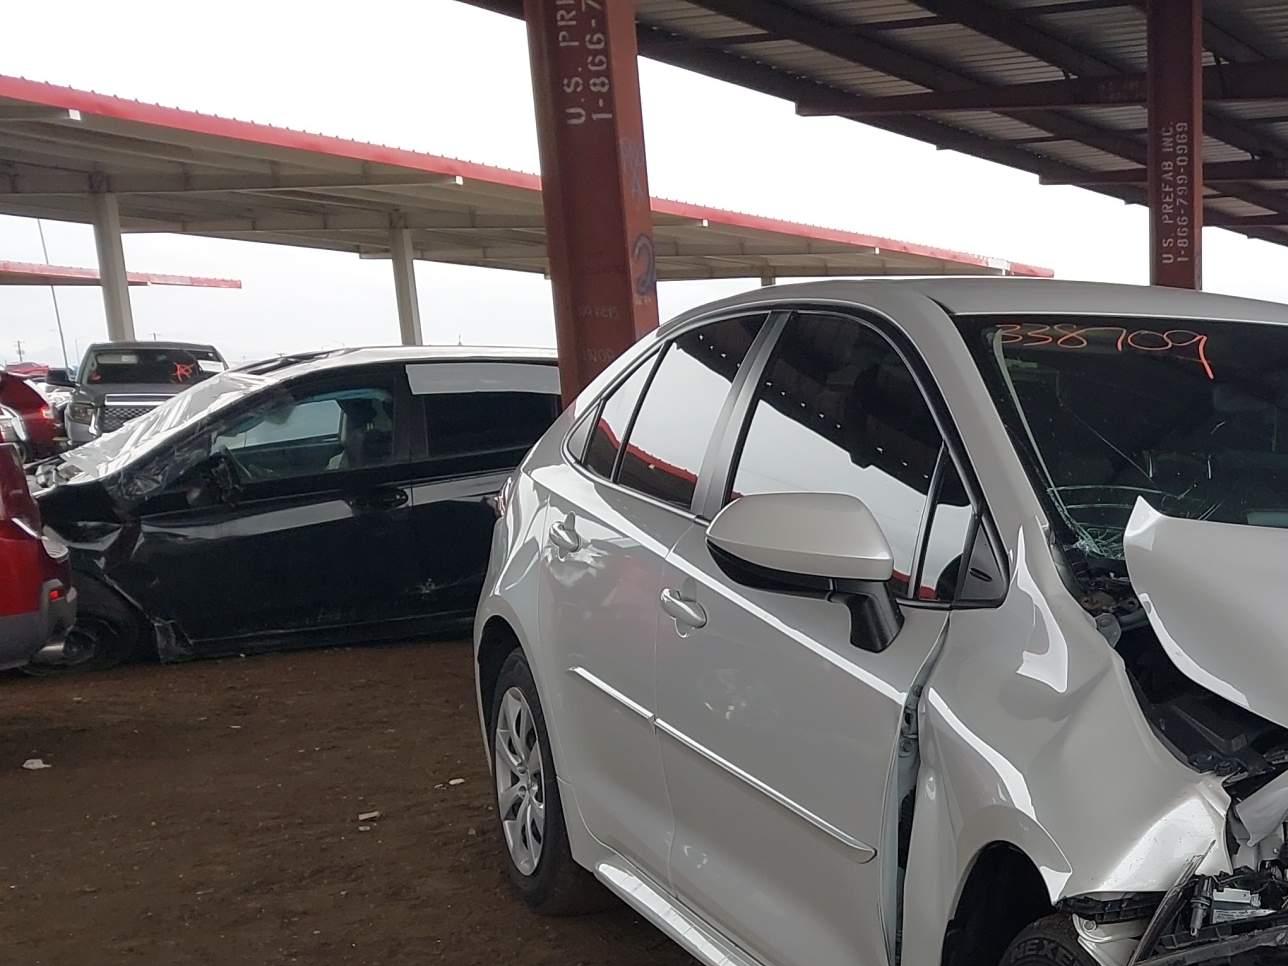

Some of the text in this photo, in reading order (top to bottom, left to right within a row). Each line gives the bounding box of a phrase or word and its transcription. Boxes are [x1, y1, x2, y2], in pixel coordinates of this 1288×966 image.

[562, 66, 587, 125] U.S.
[1161, 161, 1174, 224] PREFAB
[1175, 121, 1190, 262] 1-866-799-0969
[994, 322, 1214, 380] 338709
